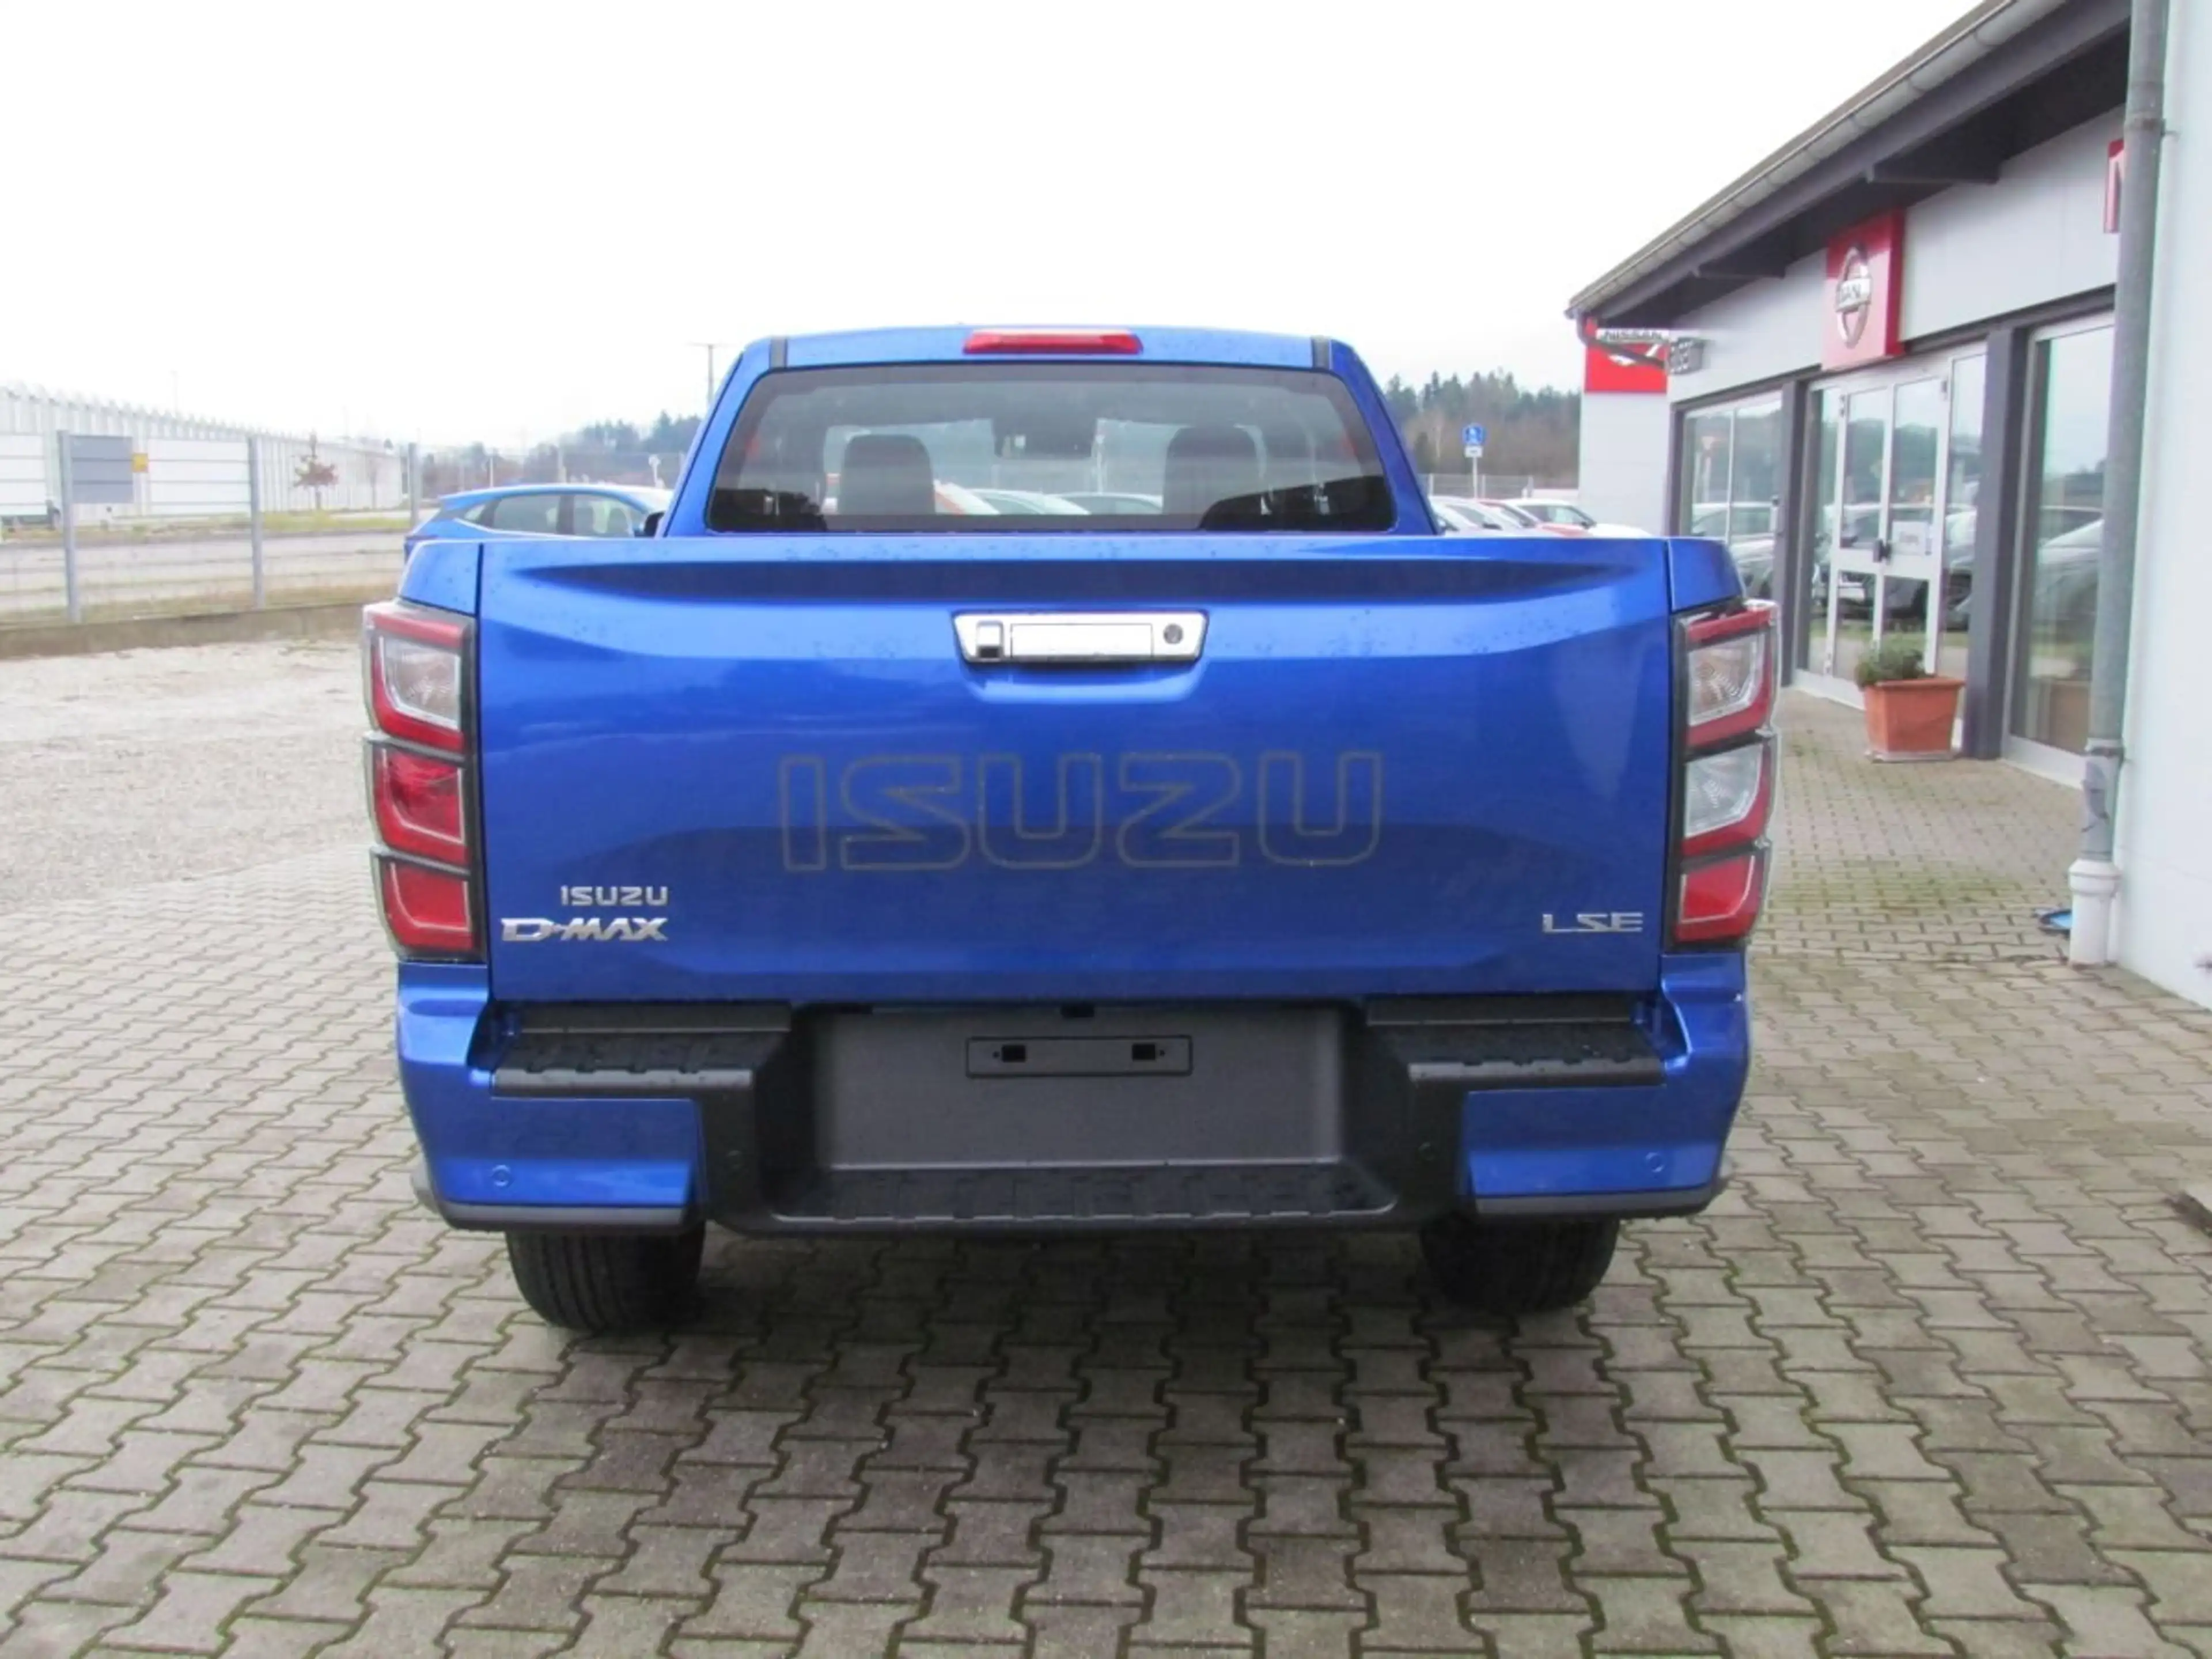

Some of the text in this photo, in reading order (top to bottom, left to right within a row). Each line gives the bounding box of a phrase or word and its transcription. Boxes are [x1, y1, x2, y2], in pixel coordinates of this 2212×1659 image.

[779, 752, 1382, 872] ISUZU
[560, 885, 668, 906] ISUZU
[501, 917, 668, 941] D-MAX
[1542, 912, 1643, 933] LSE
